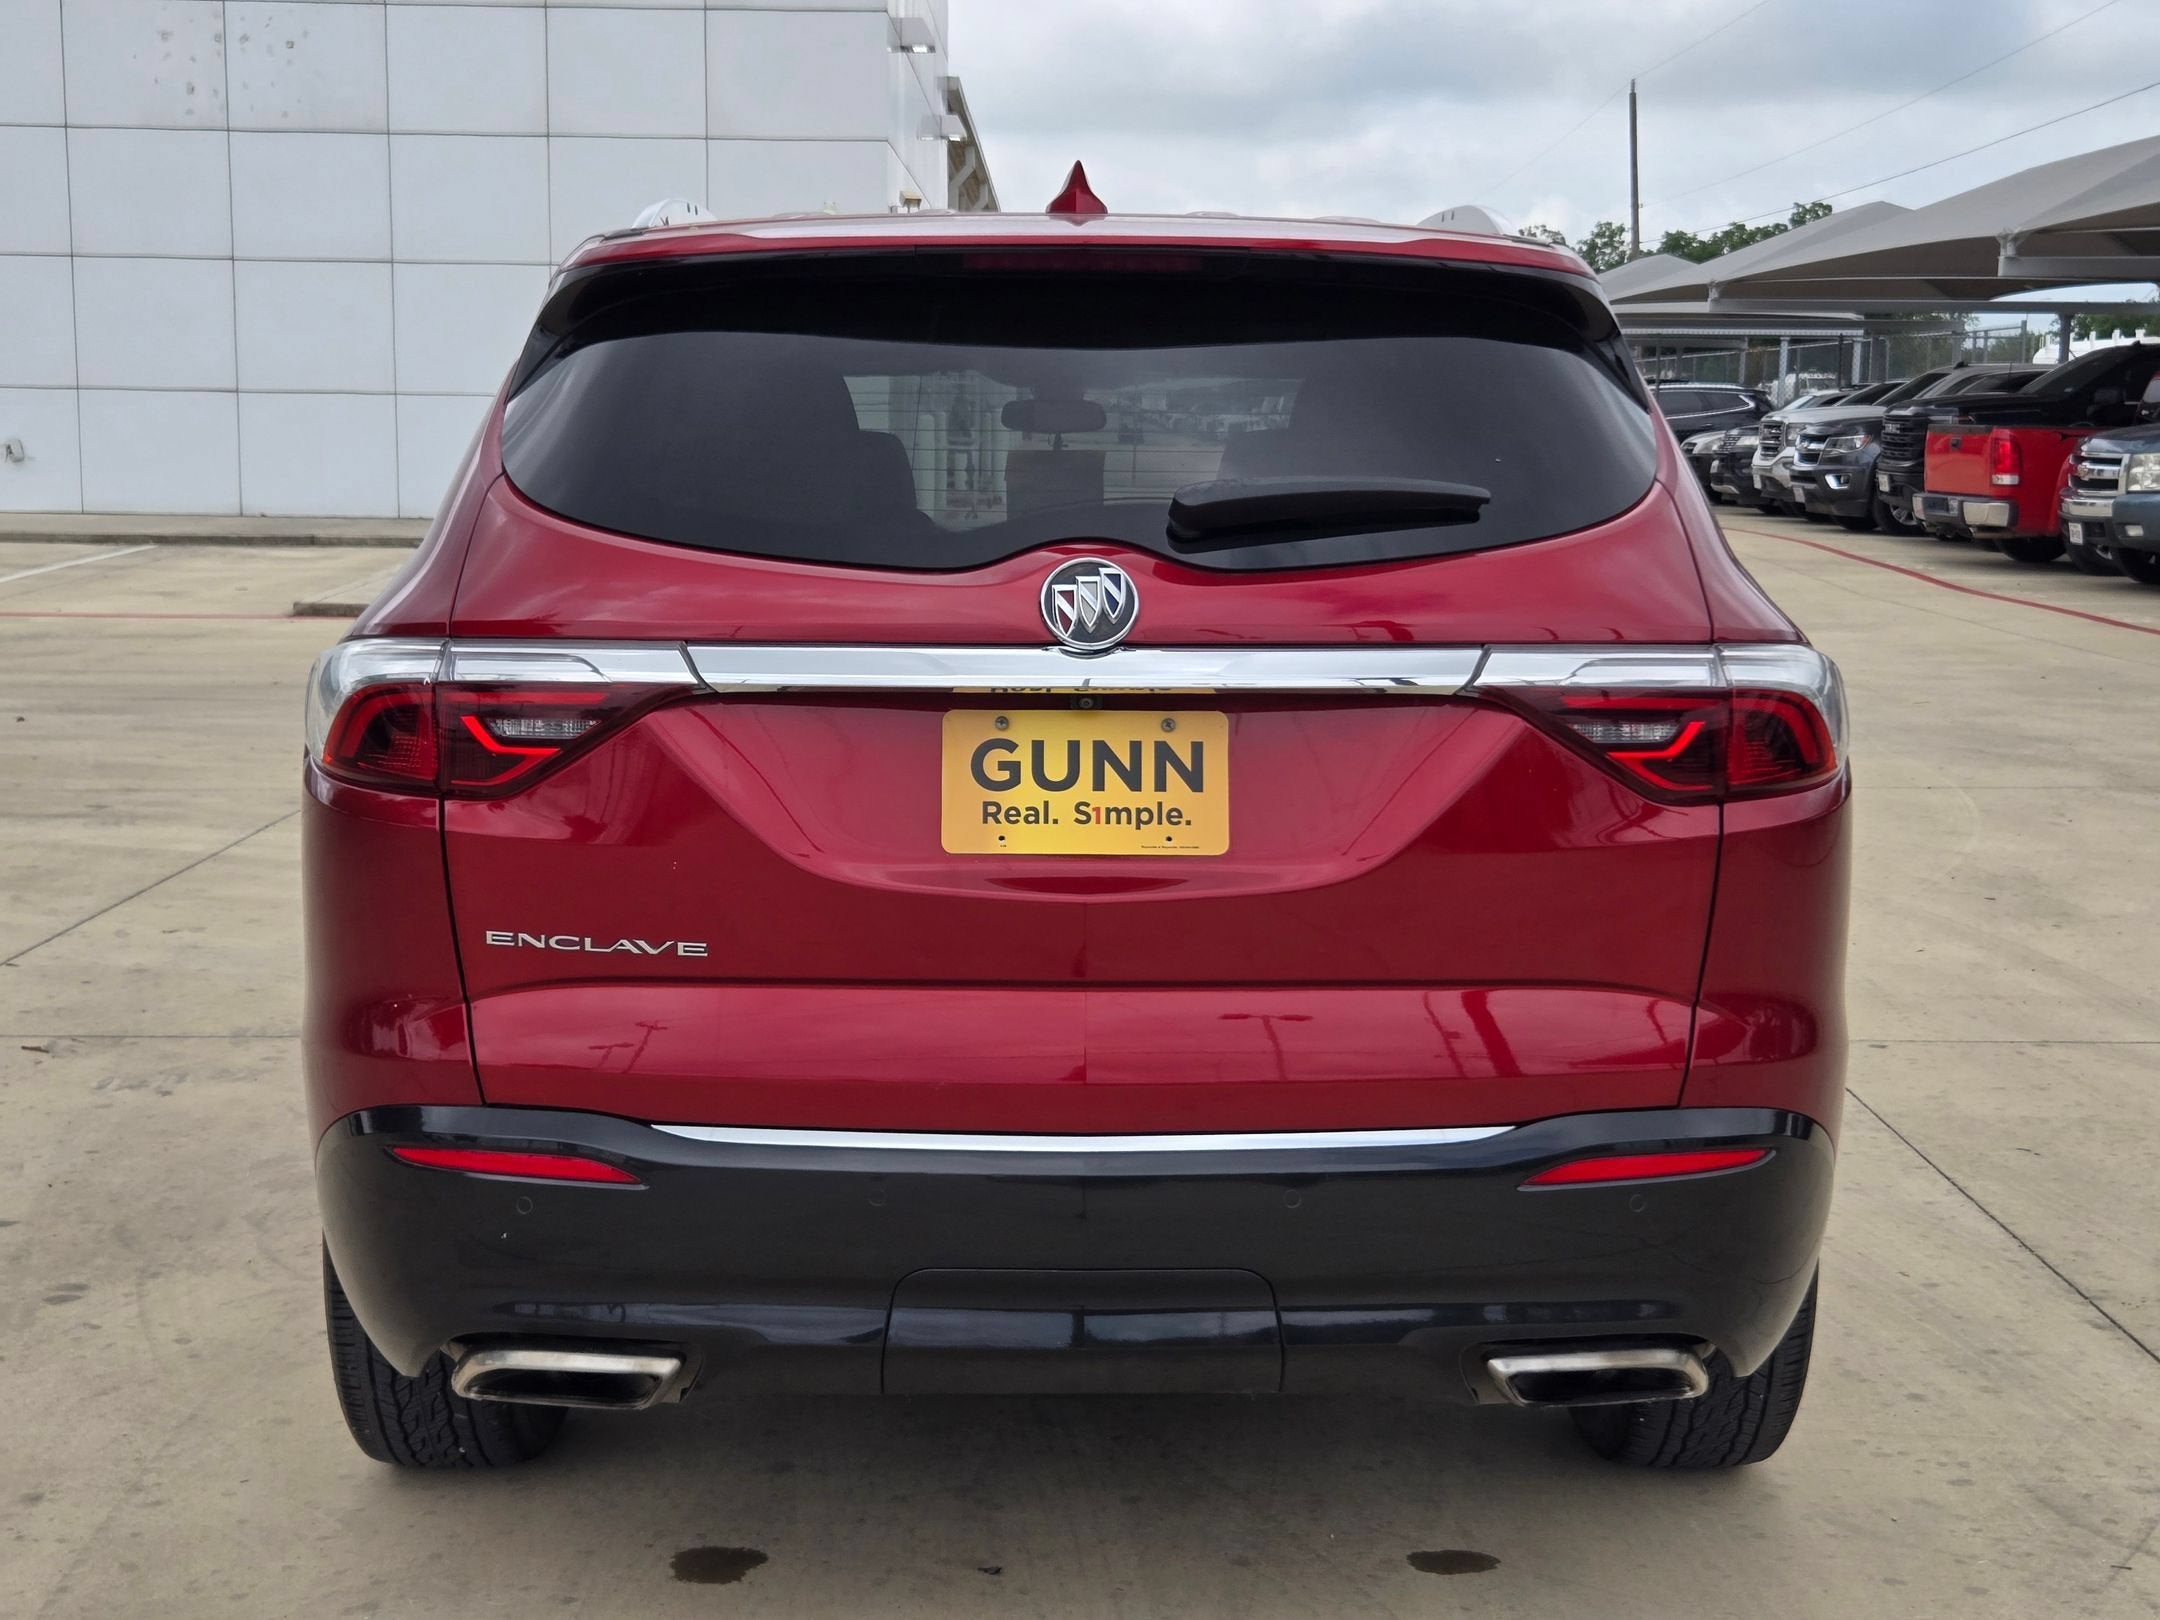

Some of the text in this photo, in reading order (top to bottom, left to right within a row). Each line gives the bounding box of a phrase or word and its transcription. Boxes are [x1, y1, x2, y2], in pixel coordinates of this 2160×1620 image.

[970, 738, 1204, 792] GUNN
[981, 801, 1059, 825] Real.
[486, 930, 708, 957] ENCLAVE
